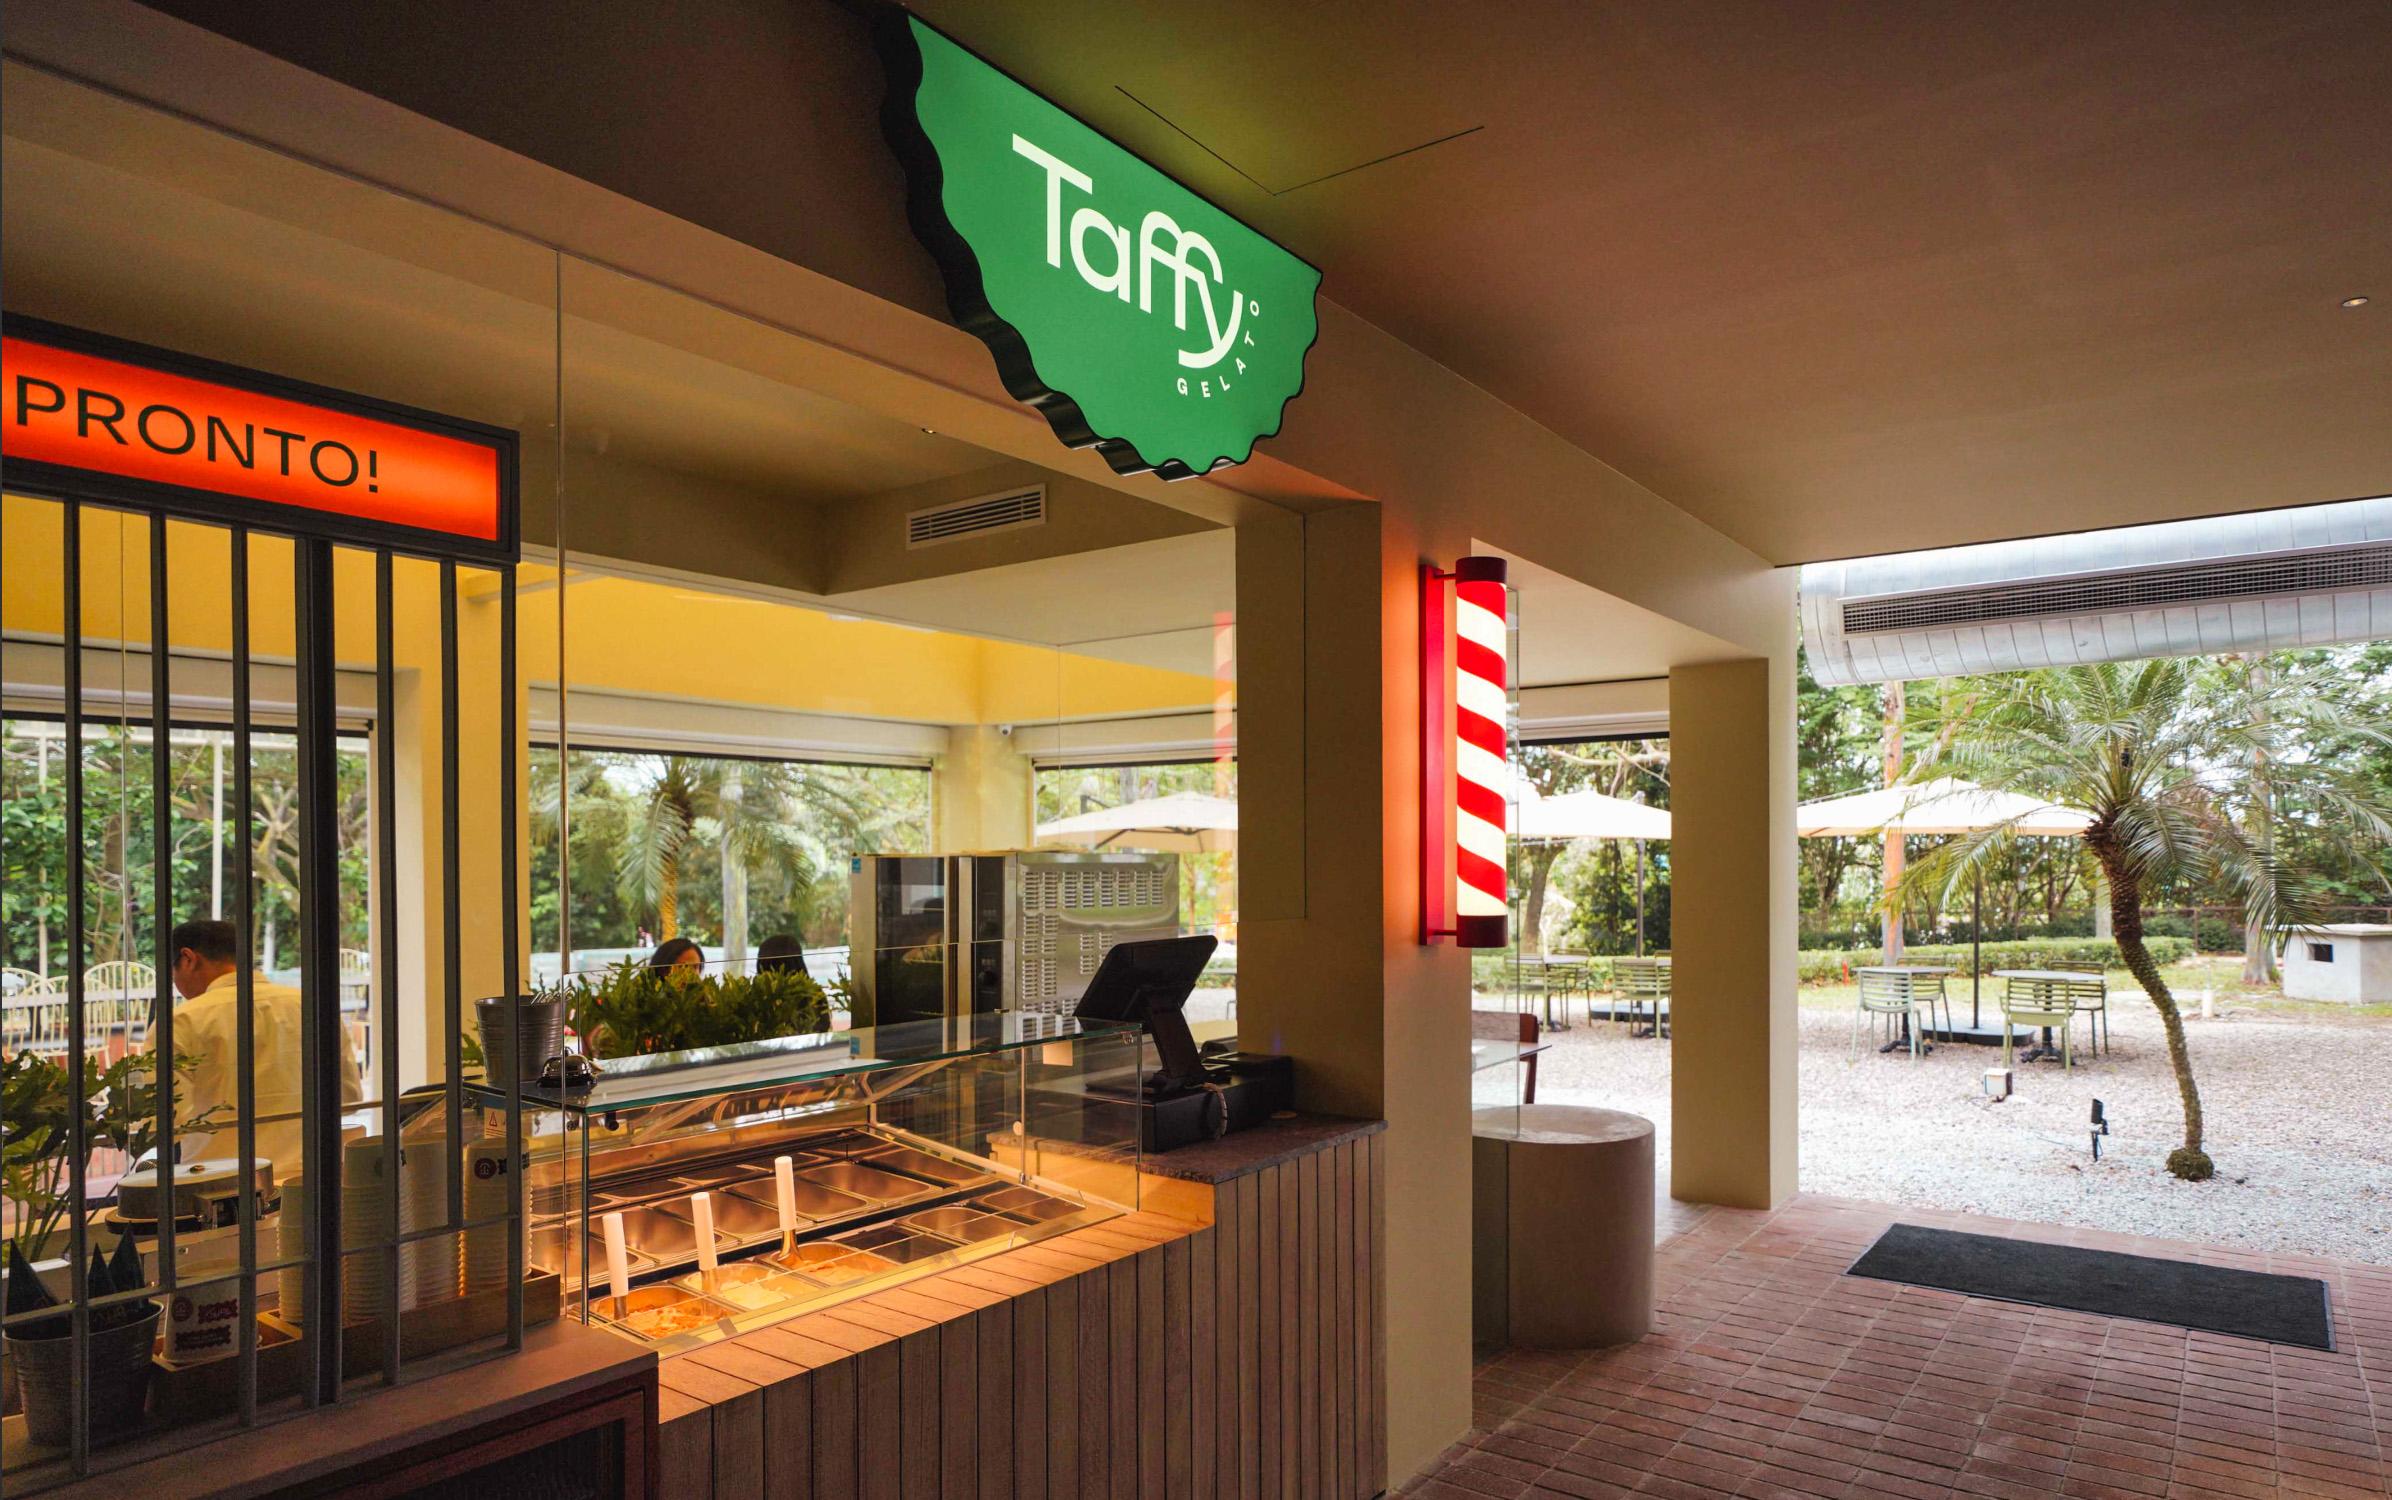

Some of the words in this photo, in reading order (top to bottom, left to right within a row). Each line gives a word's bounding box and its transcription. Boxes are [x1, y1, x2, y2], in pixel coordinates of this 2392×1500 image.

[1012, 133, 1244, 369] Taffy
[1177, 300, 1260, 398] GELATO
[16, 374, 379, 494] PRONTO!
